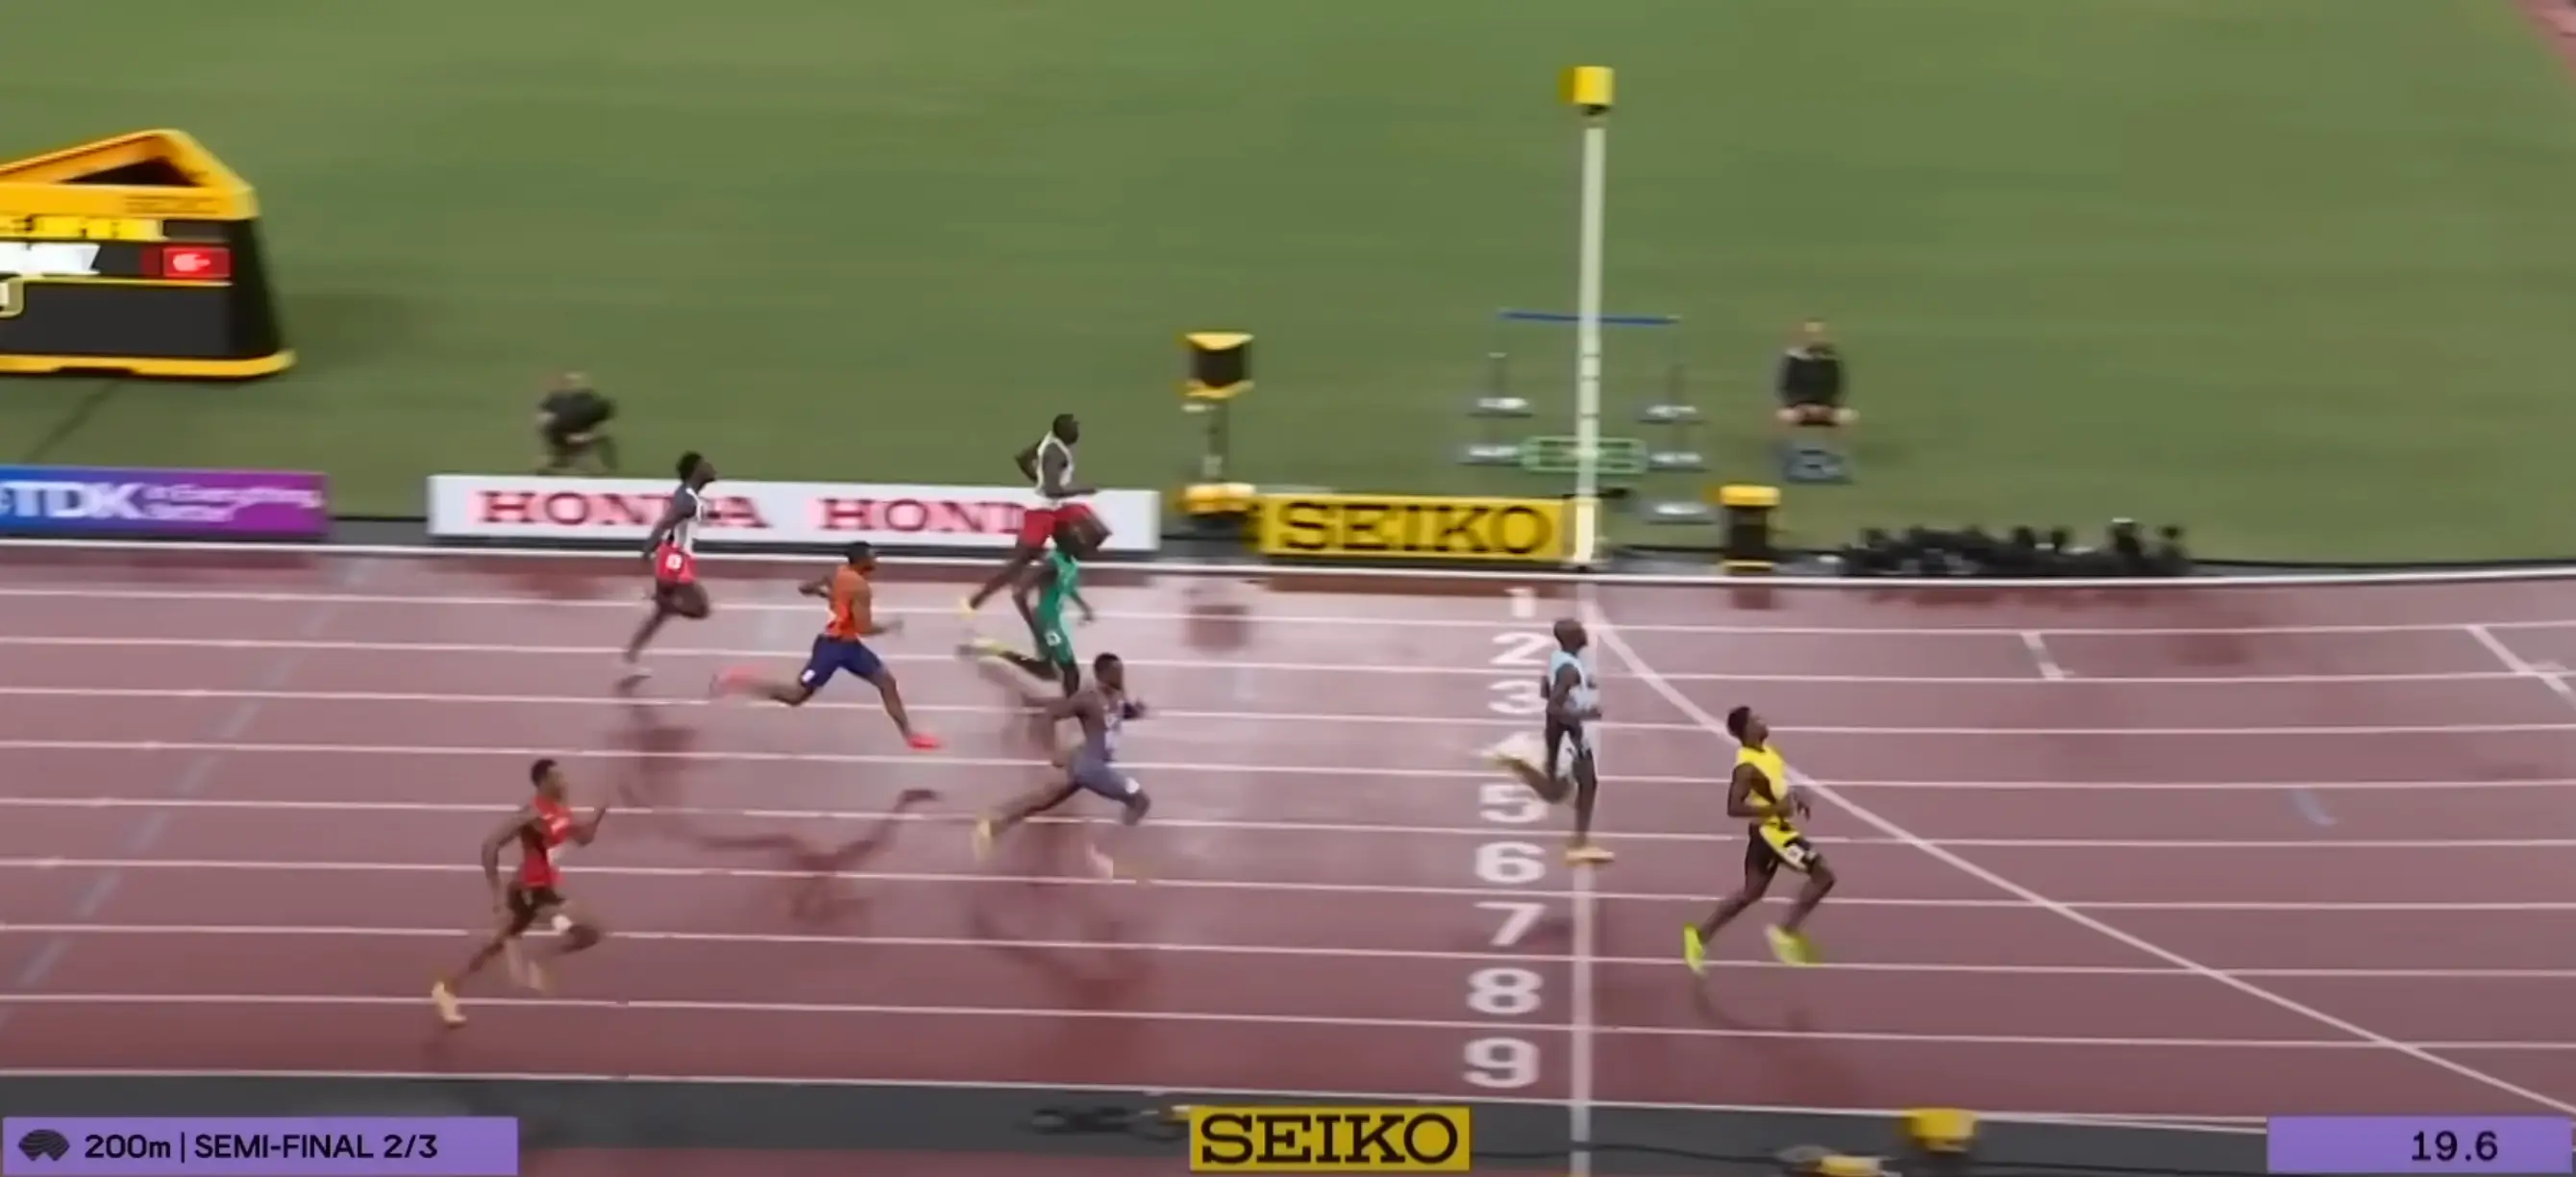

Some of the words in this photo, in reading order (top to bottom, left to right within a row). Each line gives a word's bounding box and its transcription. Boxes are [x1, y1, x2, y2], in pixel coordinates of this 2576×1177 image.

[4, 481, 144, 519] TDK
[1279, 501, 1552, 554] SEIKO
[1503, 586, 1536, 618] 1
[1489, 631, 1555, 666] 2
[1487, 679, 1549, 714] 3
[1479, 783, 1548, 823] 5
[1474, 840, 1547, 884] 6
[1474, 900, 1548, 947] 7
[1466, 966, 1544, 1015] 8
[1462, 1036, 1541, 1089] 9
[1201, 1113, 1458, 1164] SEIKO
